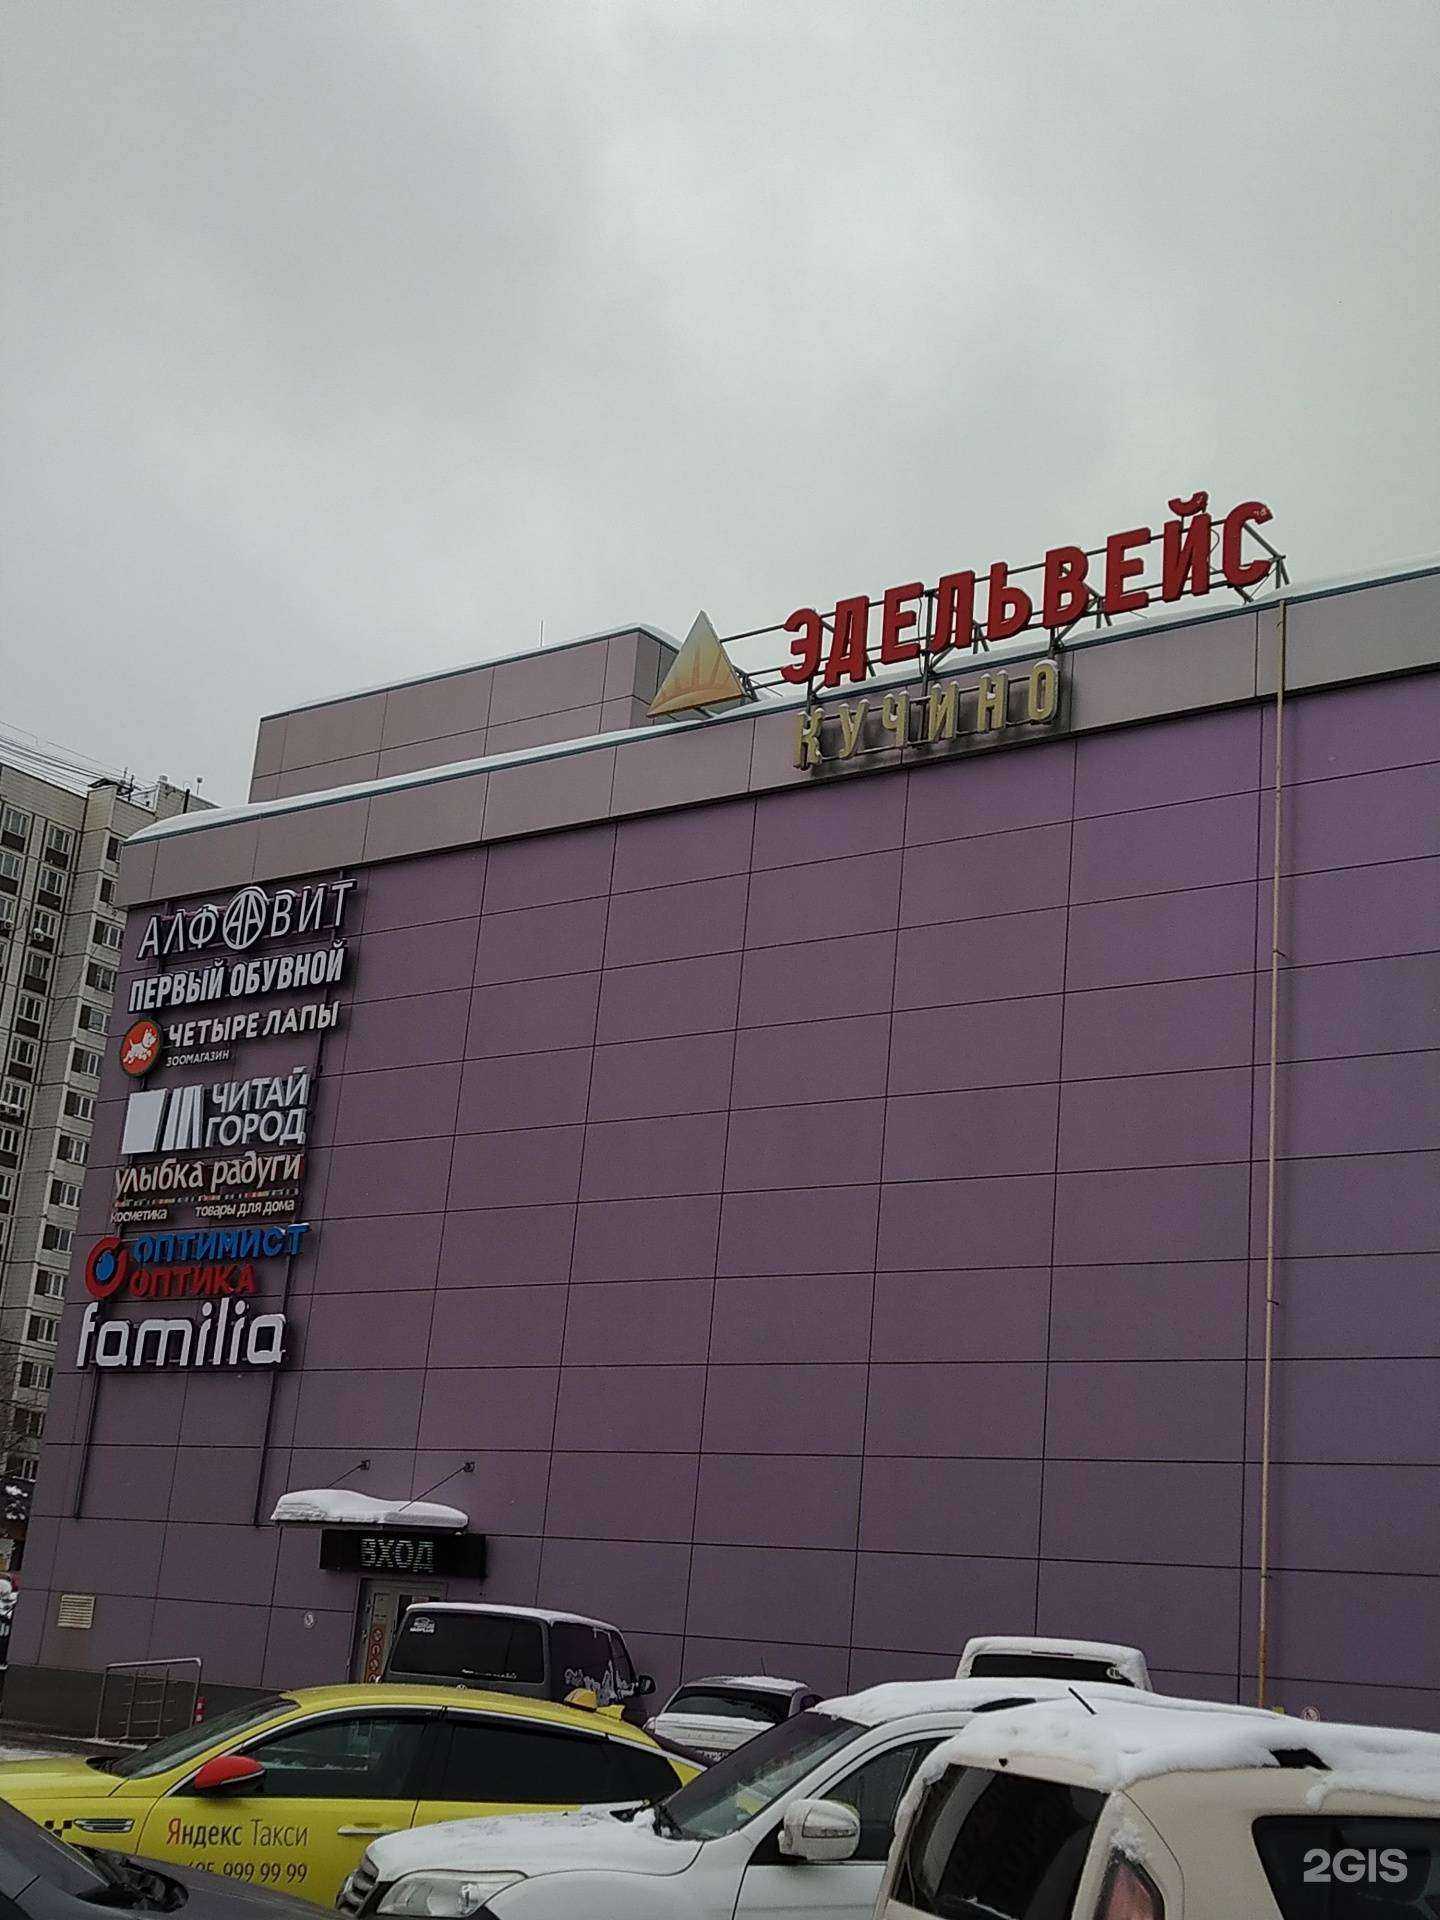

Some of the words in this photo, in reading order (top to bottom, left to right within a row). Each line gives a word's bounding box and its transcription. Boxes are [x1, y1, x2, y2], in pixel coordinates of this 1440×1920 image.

[780, 491, 1273, 688] ЭДЕЛЬВЕЙС
[794, 658, 1059, 771] КУЧИНО
[128, 958, 226, 1012] ПЕРВЫЙ
[229, 939, 346, 997] ОБУВНОЙ
[168, 1012, 261, 1048] ЧЕТЫРЕ
[262, 1000, 340, 1036] ЛАПЫ
[165, 1049, 230, 1067] ЗООМАГАЗИН
[211, 1066, 311, 1113] ЧИТАЙ
[204, 1109, 306, 1148] ГОРОД
[210, 1150, 303, 1193] радуги
[110, 1208, 168, 1224] косметика
[195, 1203, 236, 1219] товары
[236, 1202, 262, 1217] для
[262, 1199, 295, 1216] дома
[132, 1223, 310, 1264] ОПТИМИСТ
[129, 1263, 257, 1298] ОПТИКА
[76, 1297, 287, 1368] familia
[360, 1538, 435, 1573] ВХОД
[166, 1817, 243, 1849] Яндекс
[250, 1818, 309, 1847] Такси
[223, 1862, 255, 1883] 999
[260, 1863, 281, 1883] 99
[283, 1863, 307, 1884] 99
